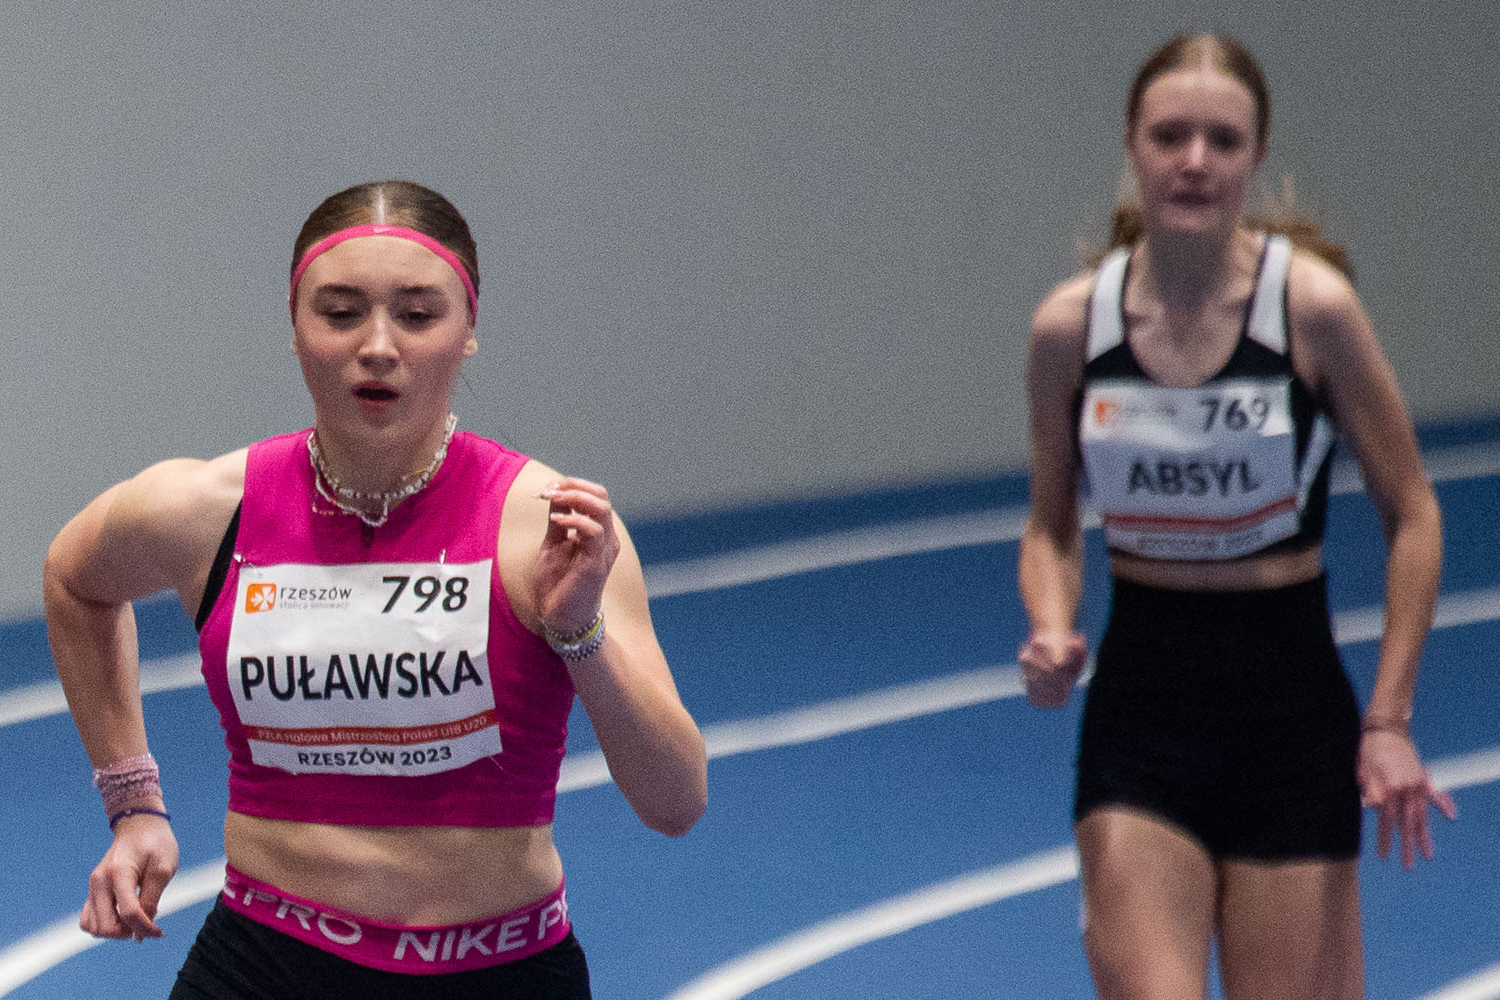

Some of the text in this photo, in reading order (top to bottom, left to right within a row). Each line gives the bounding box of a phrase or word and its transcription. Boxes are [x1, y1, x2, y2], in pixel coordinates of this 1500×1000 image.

[1202, 399, 1270, 431] 769
[1129, 457, 1260, 496] ABSYL
[280, 576, 469, 613] rzeszów 798
[240, 650, 483, 701] PUŁAWSKA
[298, 746, 453, 767] RZESZÓW 2023
[393, 917, 530, 962] NIKE
